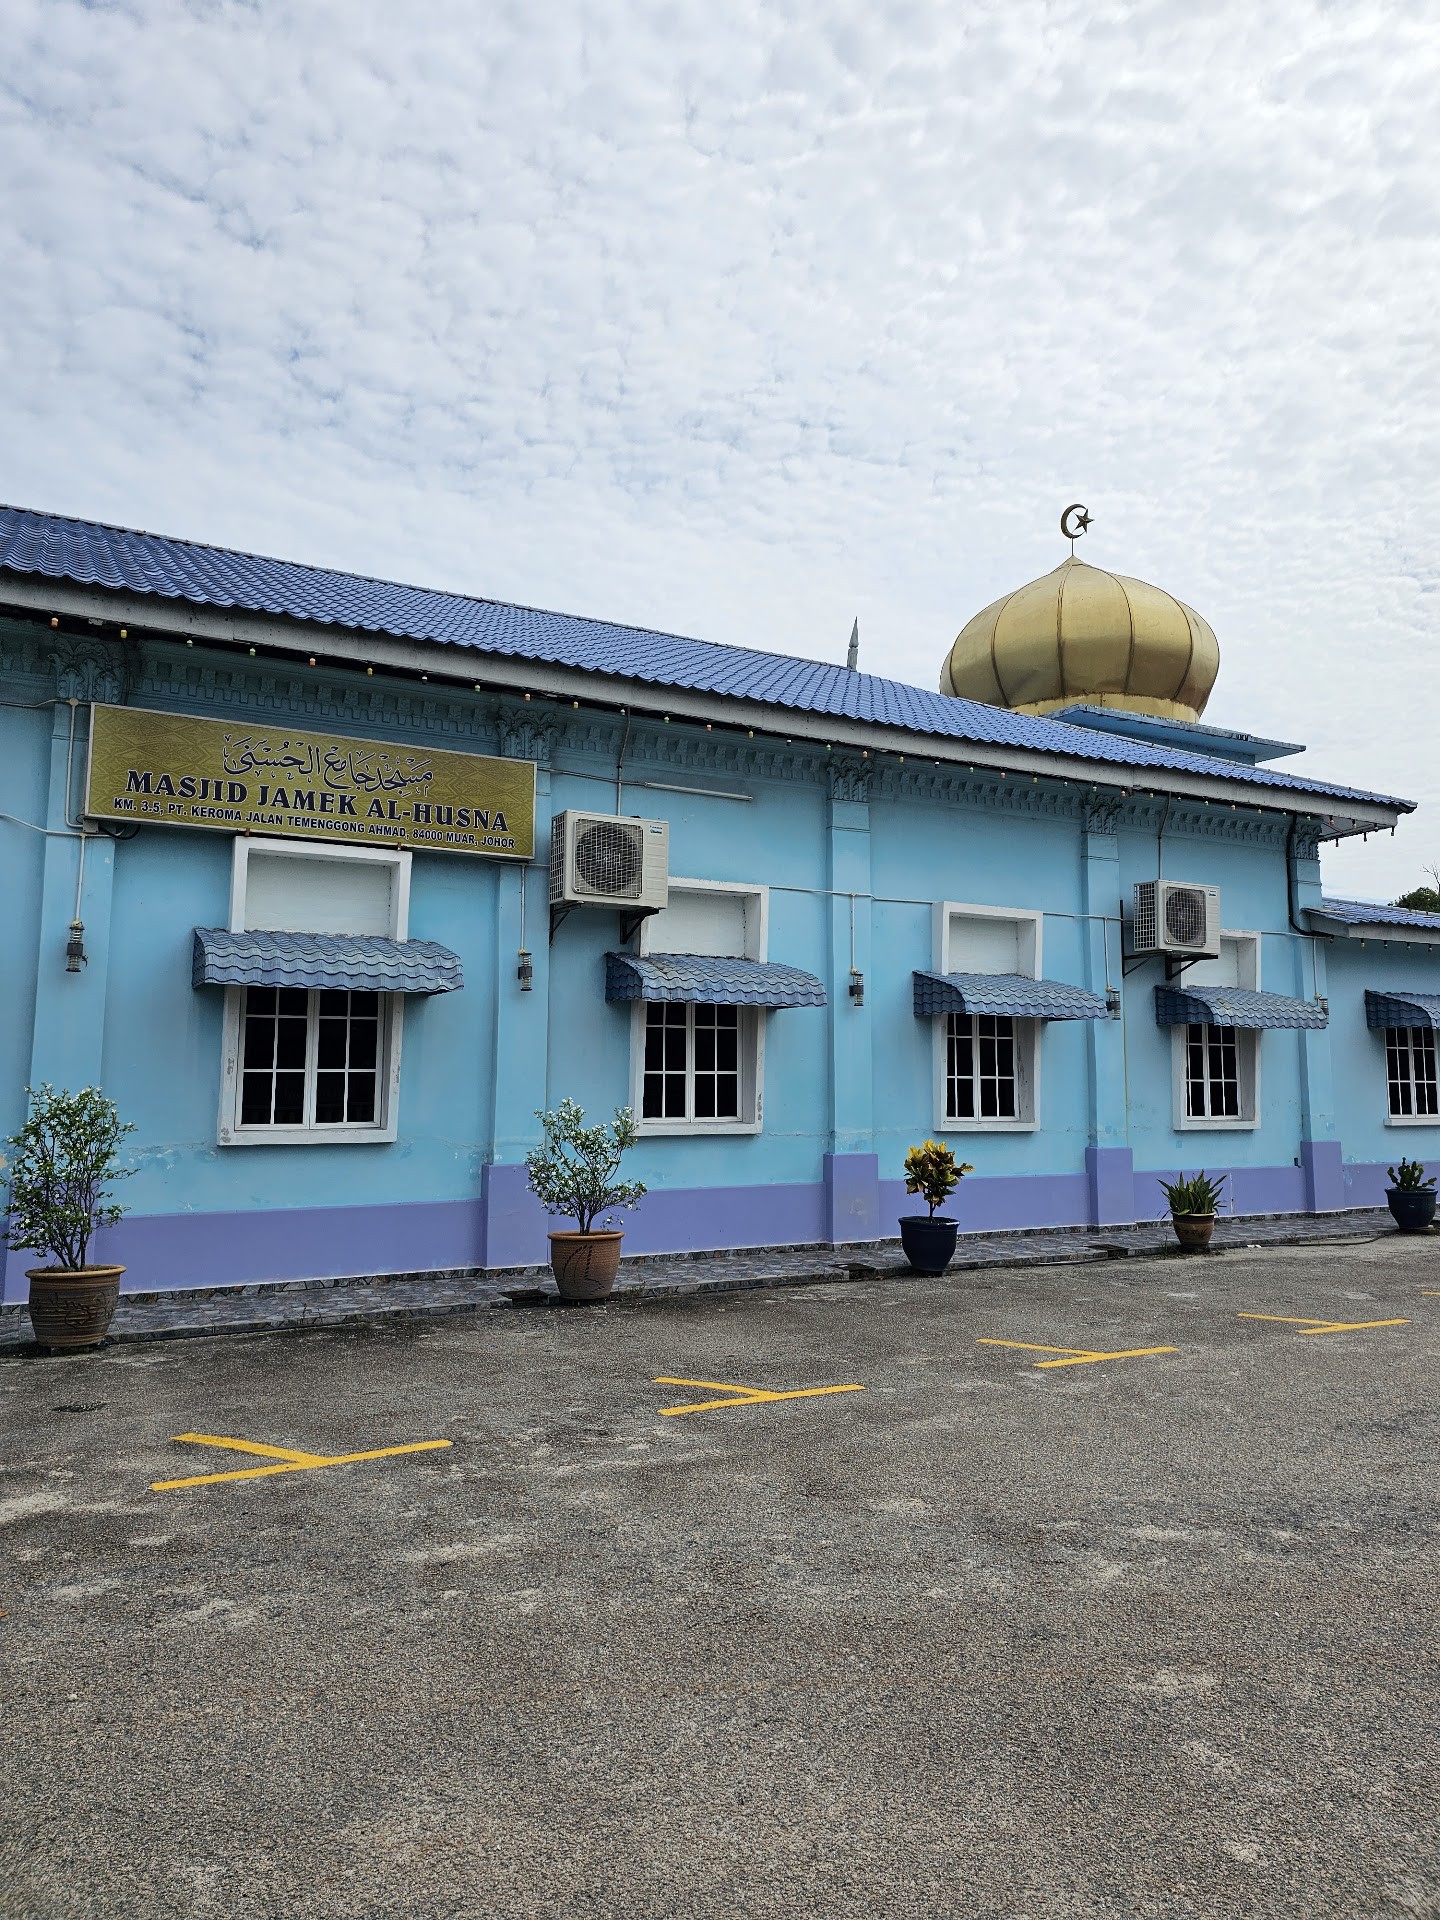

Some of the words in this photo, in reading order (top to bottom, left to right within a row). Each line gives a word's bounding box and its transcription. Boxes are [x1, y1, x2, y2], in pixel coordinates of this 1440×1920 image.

[114, 797, 137, 811] KM.
[141, 801, 164, 816] 3.5,
[167, 803, 188, 816] PT.
[191, 805, 242, 821] KEROMA
[246, 811, 283, 826] JALAN
[287, 816, 365, 833] TEMENGGONG
[368, 823, 410, 839] AHMAD,
[412, 828, 443, 841] 84000
[446, 832, 478, 846] MUAR,
[481, 836, 515, 849] JOHOR
[125, 770, 248, 804] MASJID
[257, 785, 358, 817] JAMEK
[366, 797, 509, 832] AL-HUSNA
